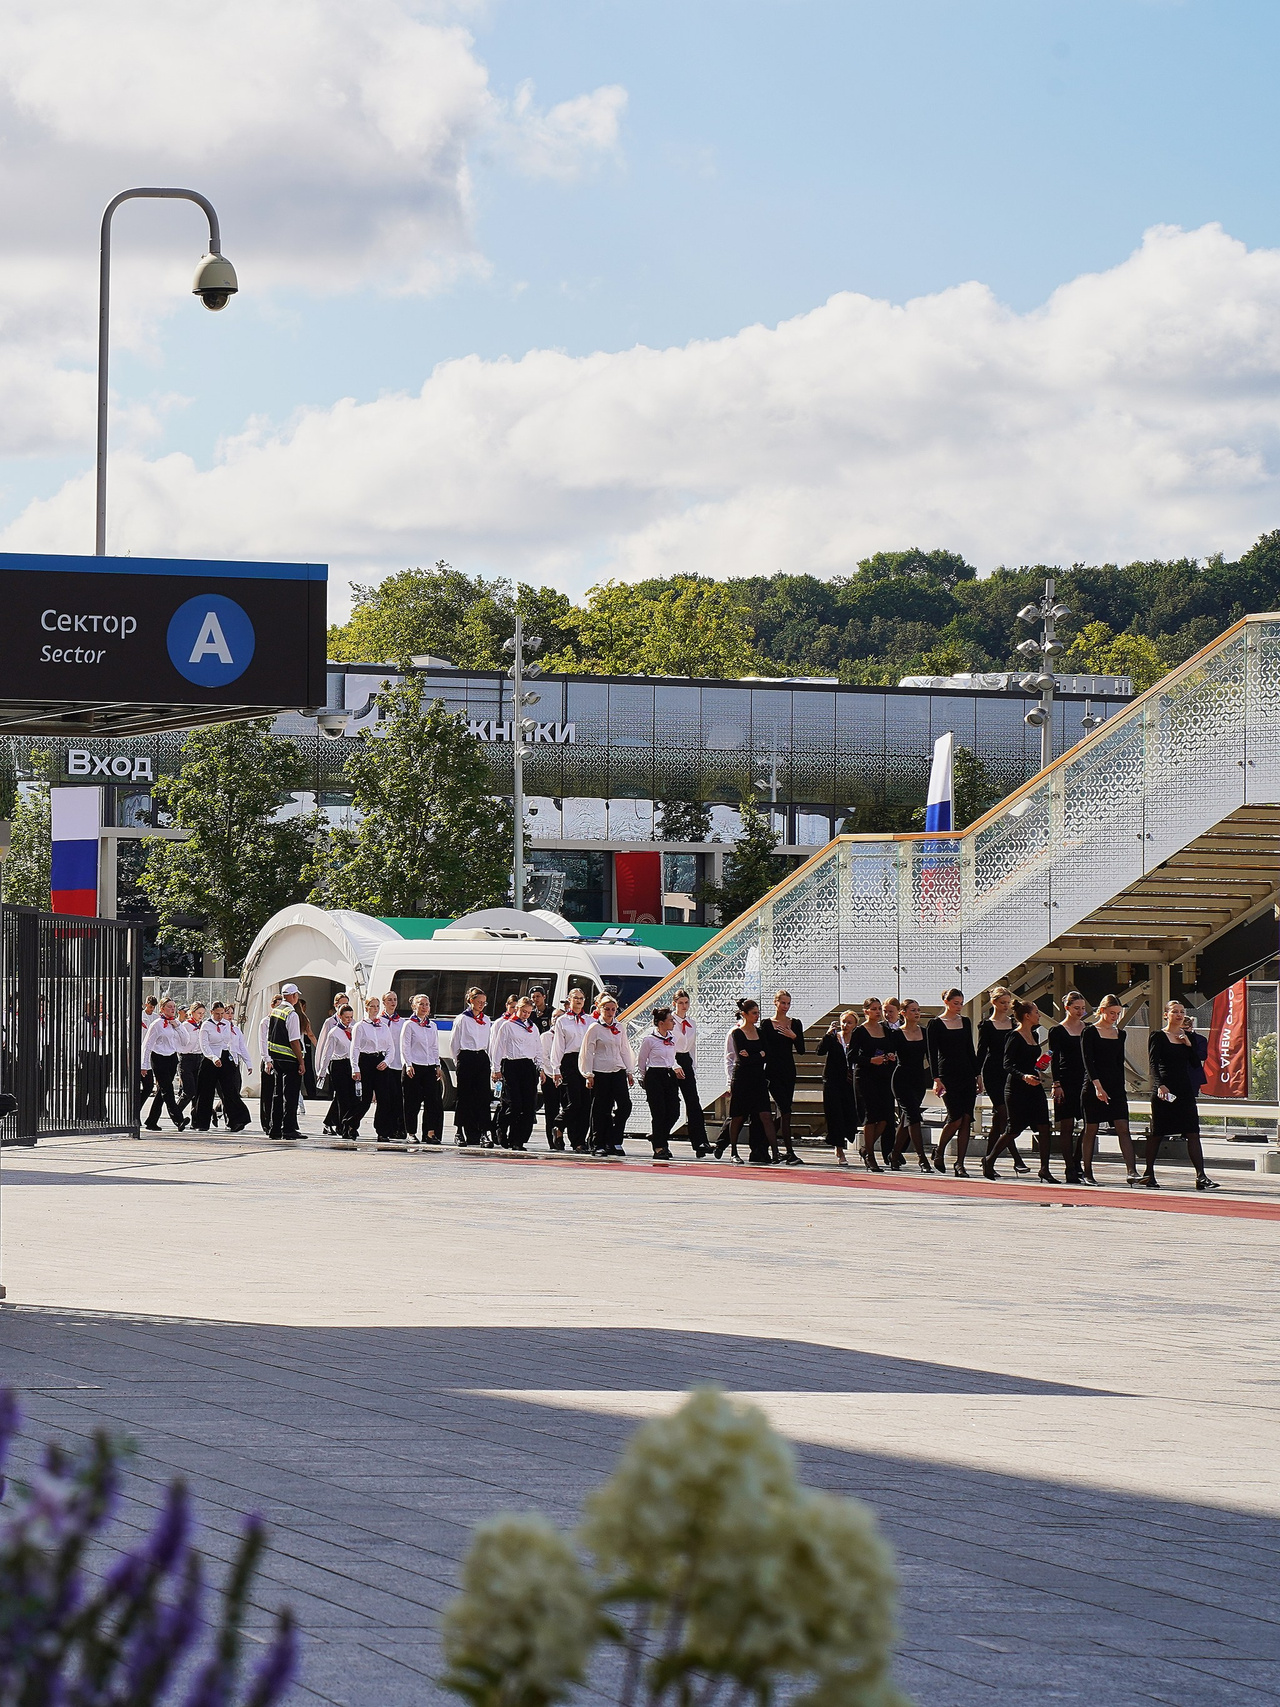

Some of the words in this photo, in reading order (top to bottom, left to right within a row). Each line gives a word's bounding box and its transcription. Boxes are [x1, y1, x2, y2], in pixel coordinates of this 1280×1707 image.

[40, 609, 138, 639] Сектор
[39, 644, 107, 664] Sector
[68, 749, 154, 782] Вход
